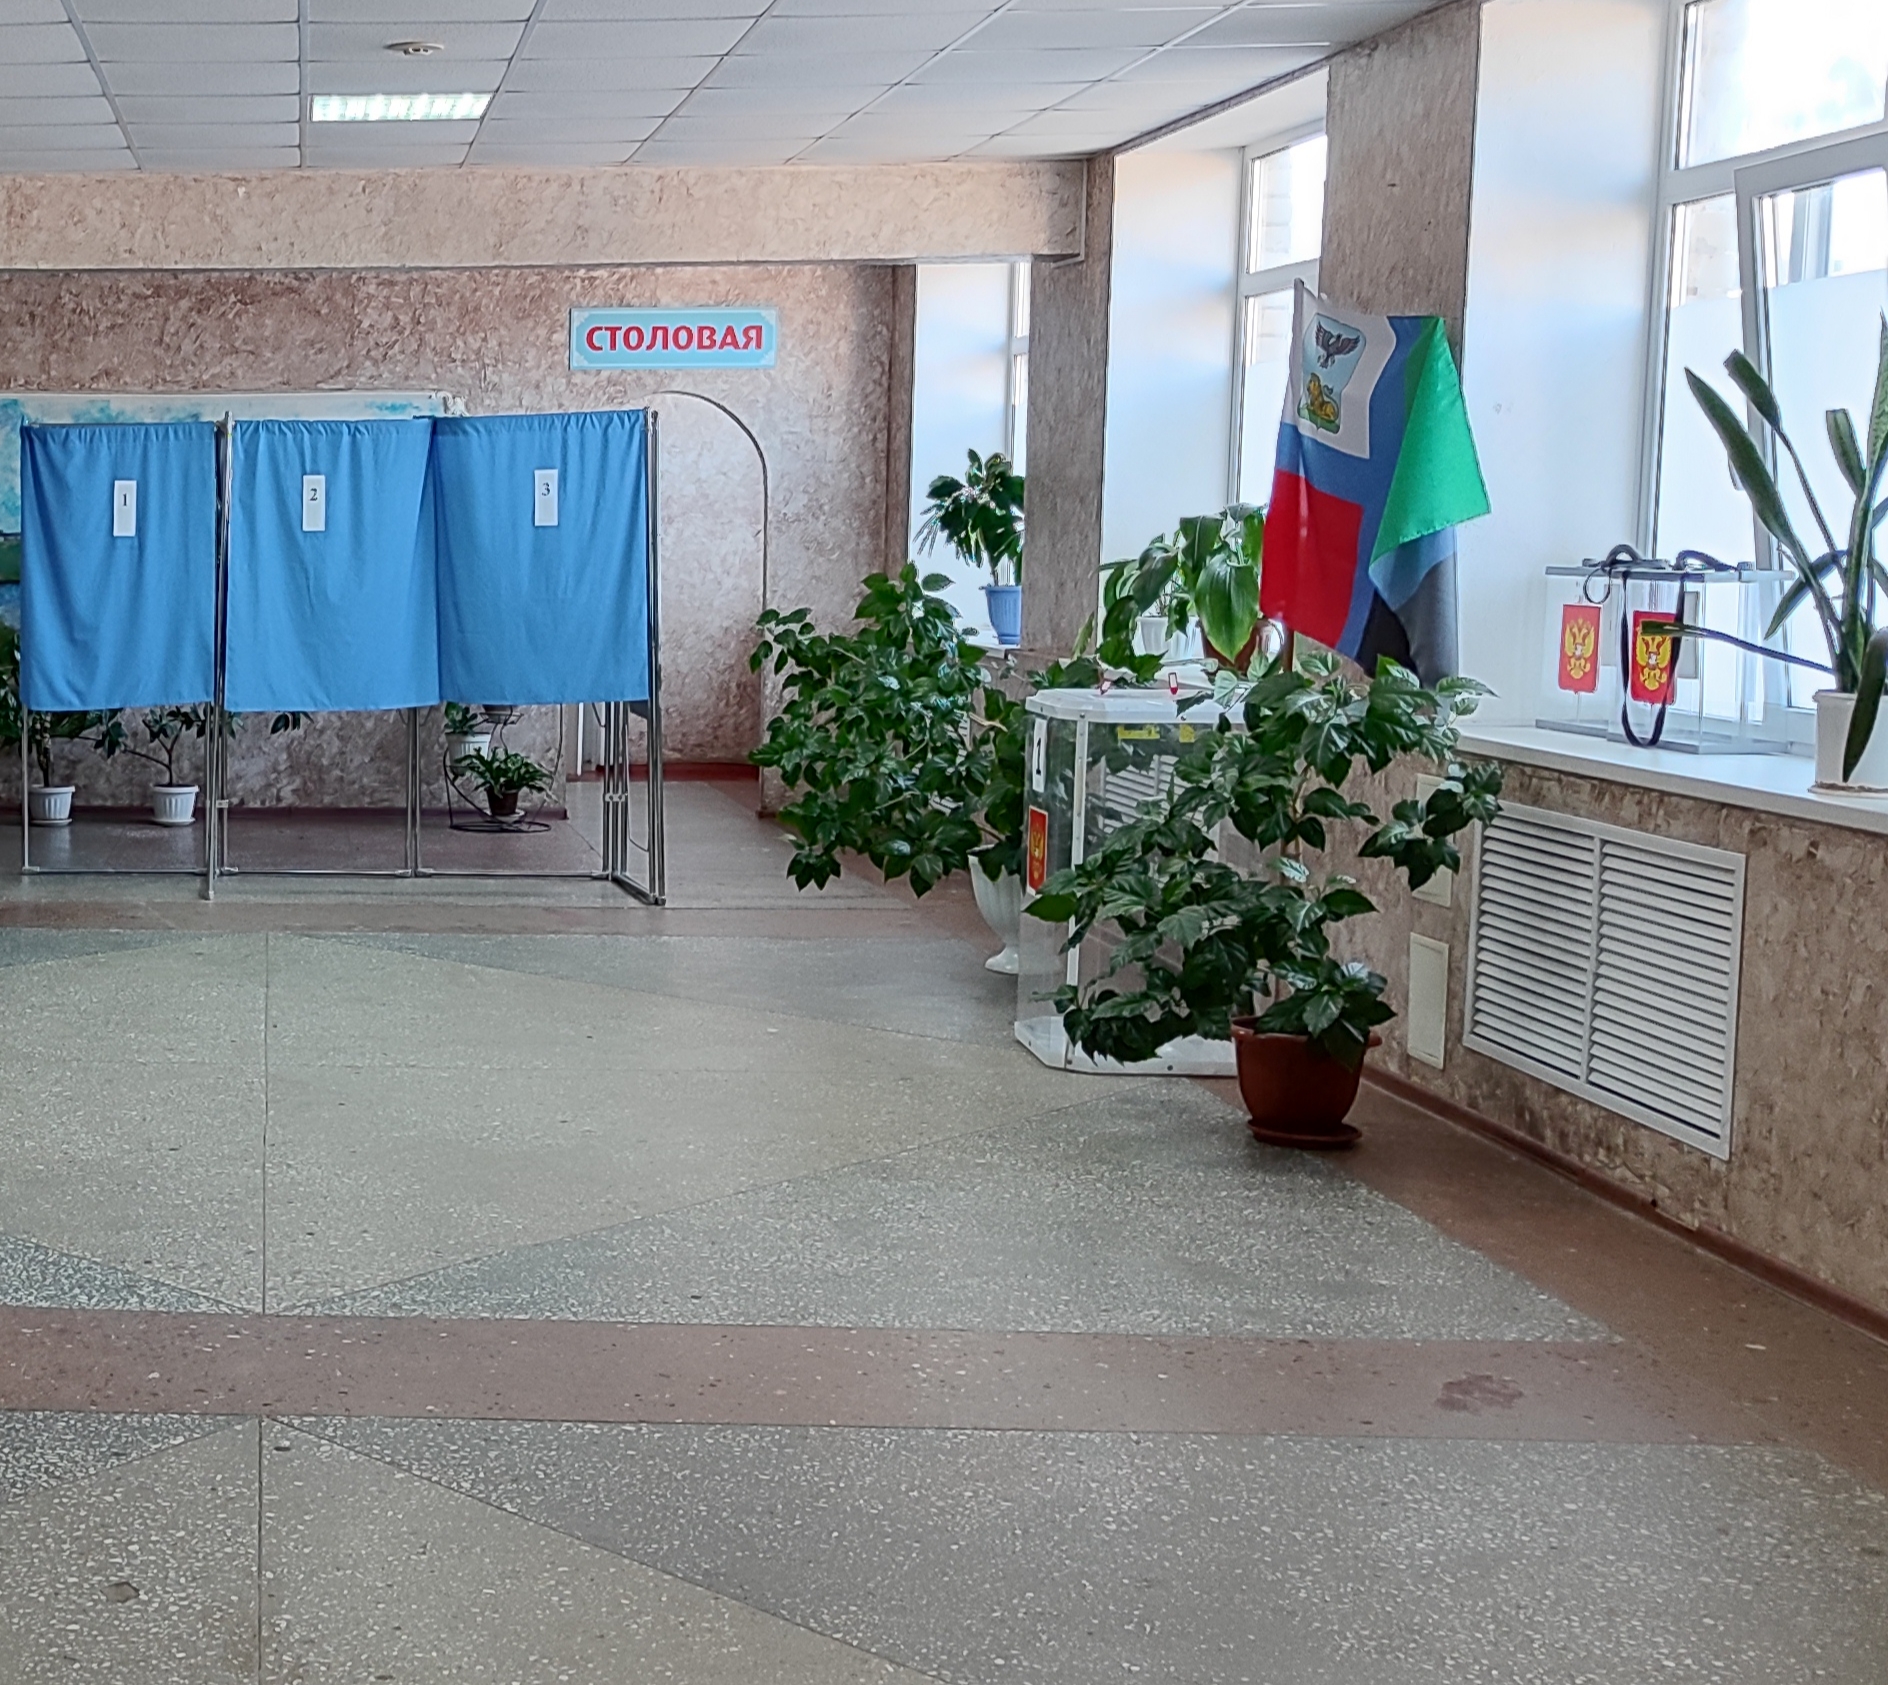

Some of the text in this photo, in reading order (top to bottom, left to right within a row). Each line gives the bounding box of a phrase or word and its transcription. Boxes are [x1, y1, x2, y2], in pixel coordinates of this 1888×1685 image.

[586, 325, 762, 351] СТОЛОВАЯ
[310, 488, 318, 501] 2
[542, 482, 550, 496] 3
[122, 493, 128, 507] 1
